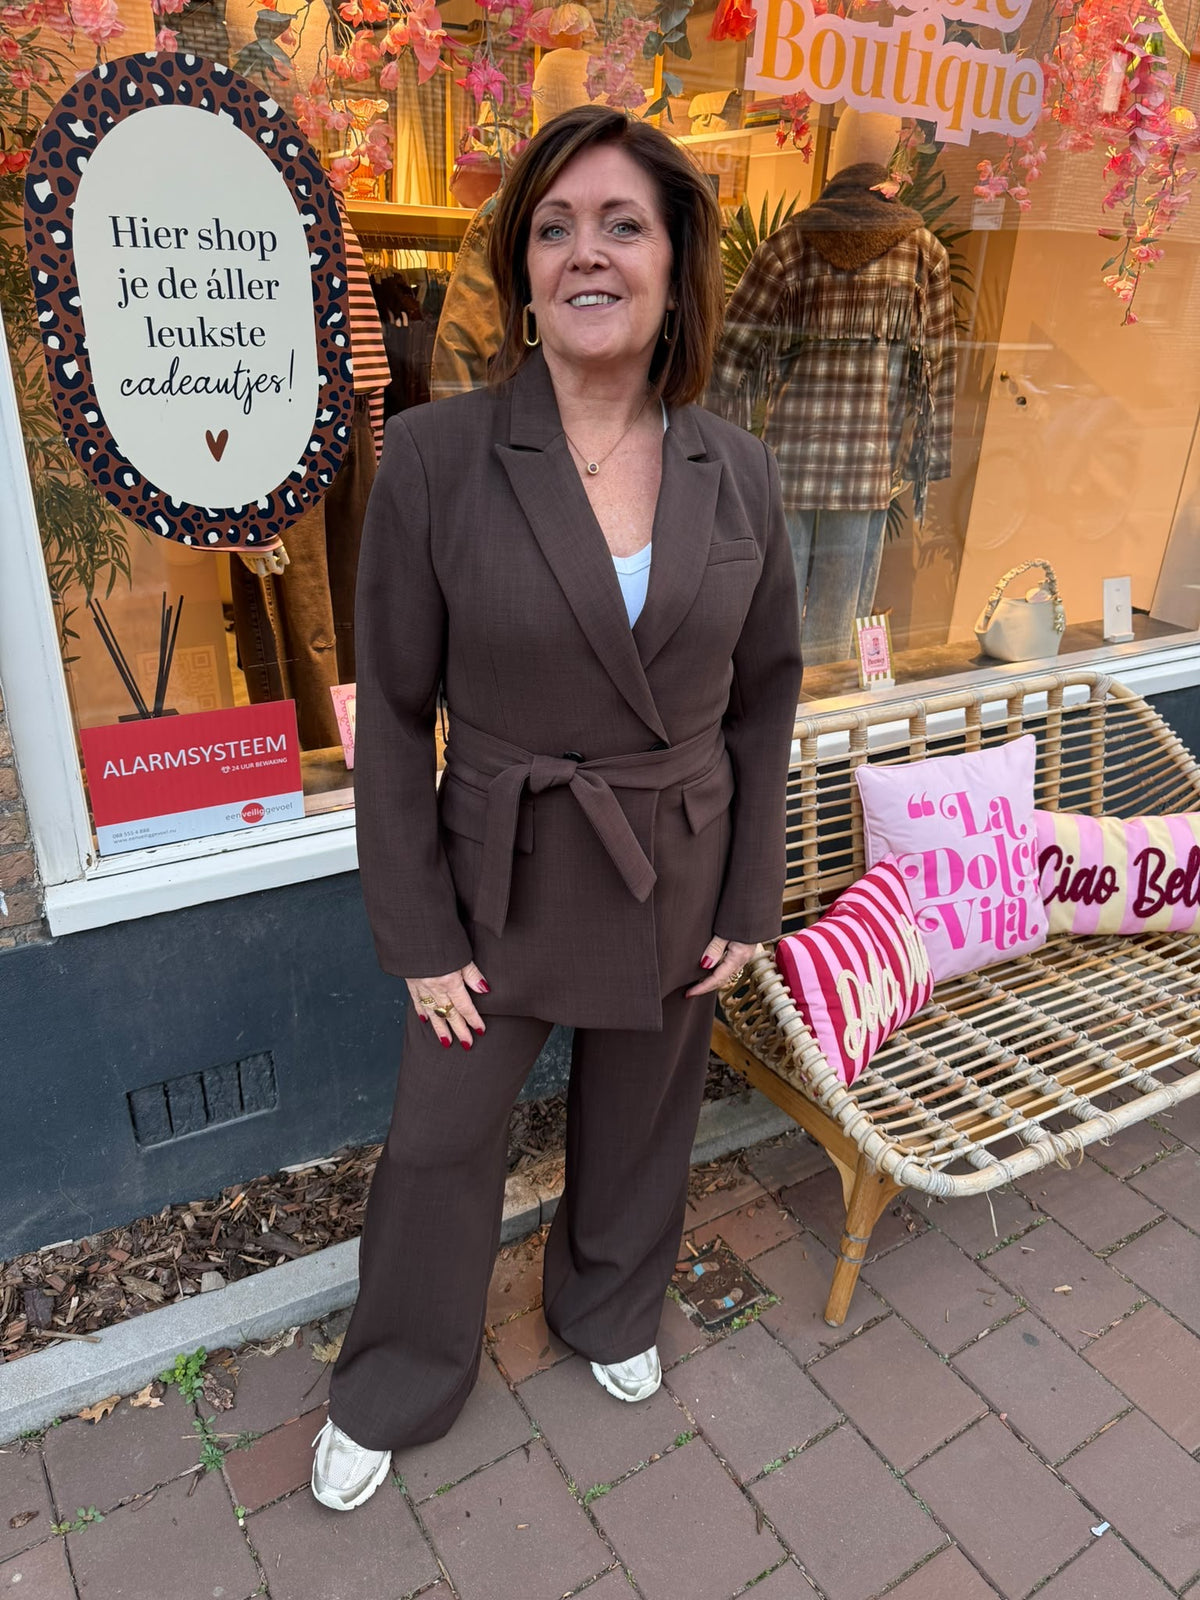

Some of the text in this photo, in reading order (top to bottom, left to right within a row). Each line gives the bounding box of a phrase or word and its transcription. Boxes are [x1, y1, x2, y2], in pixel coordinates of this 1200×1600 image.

[756, 0, 1037, 131] Boutique
[108, 216, 277, 261] Hier shop
[117, 266, 280, 308] je de áller
[143, 316, 266, 348] leukste
[120, 349, 295, 415] cadeautjes!
[103, 734, 287, 779] ALARMSYSTEEM
[240, 762, 255, 770] UUR
[255, 757, 288, 768] BEWAKING
[1038, 845, 1200, 918] Ciao Bel
[914, 895, 1039, 950] Vita
